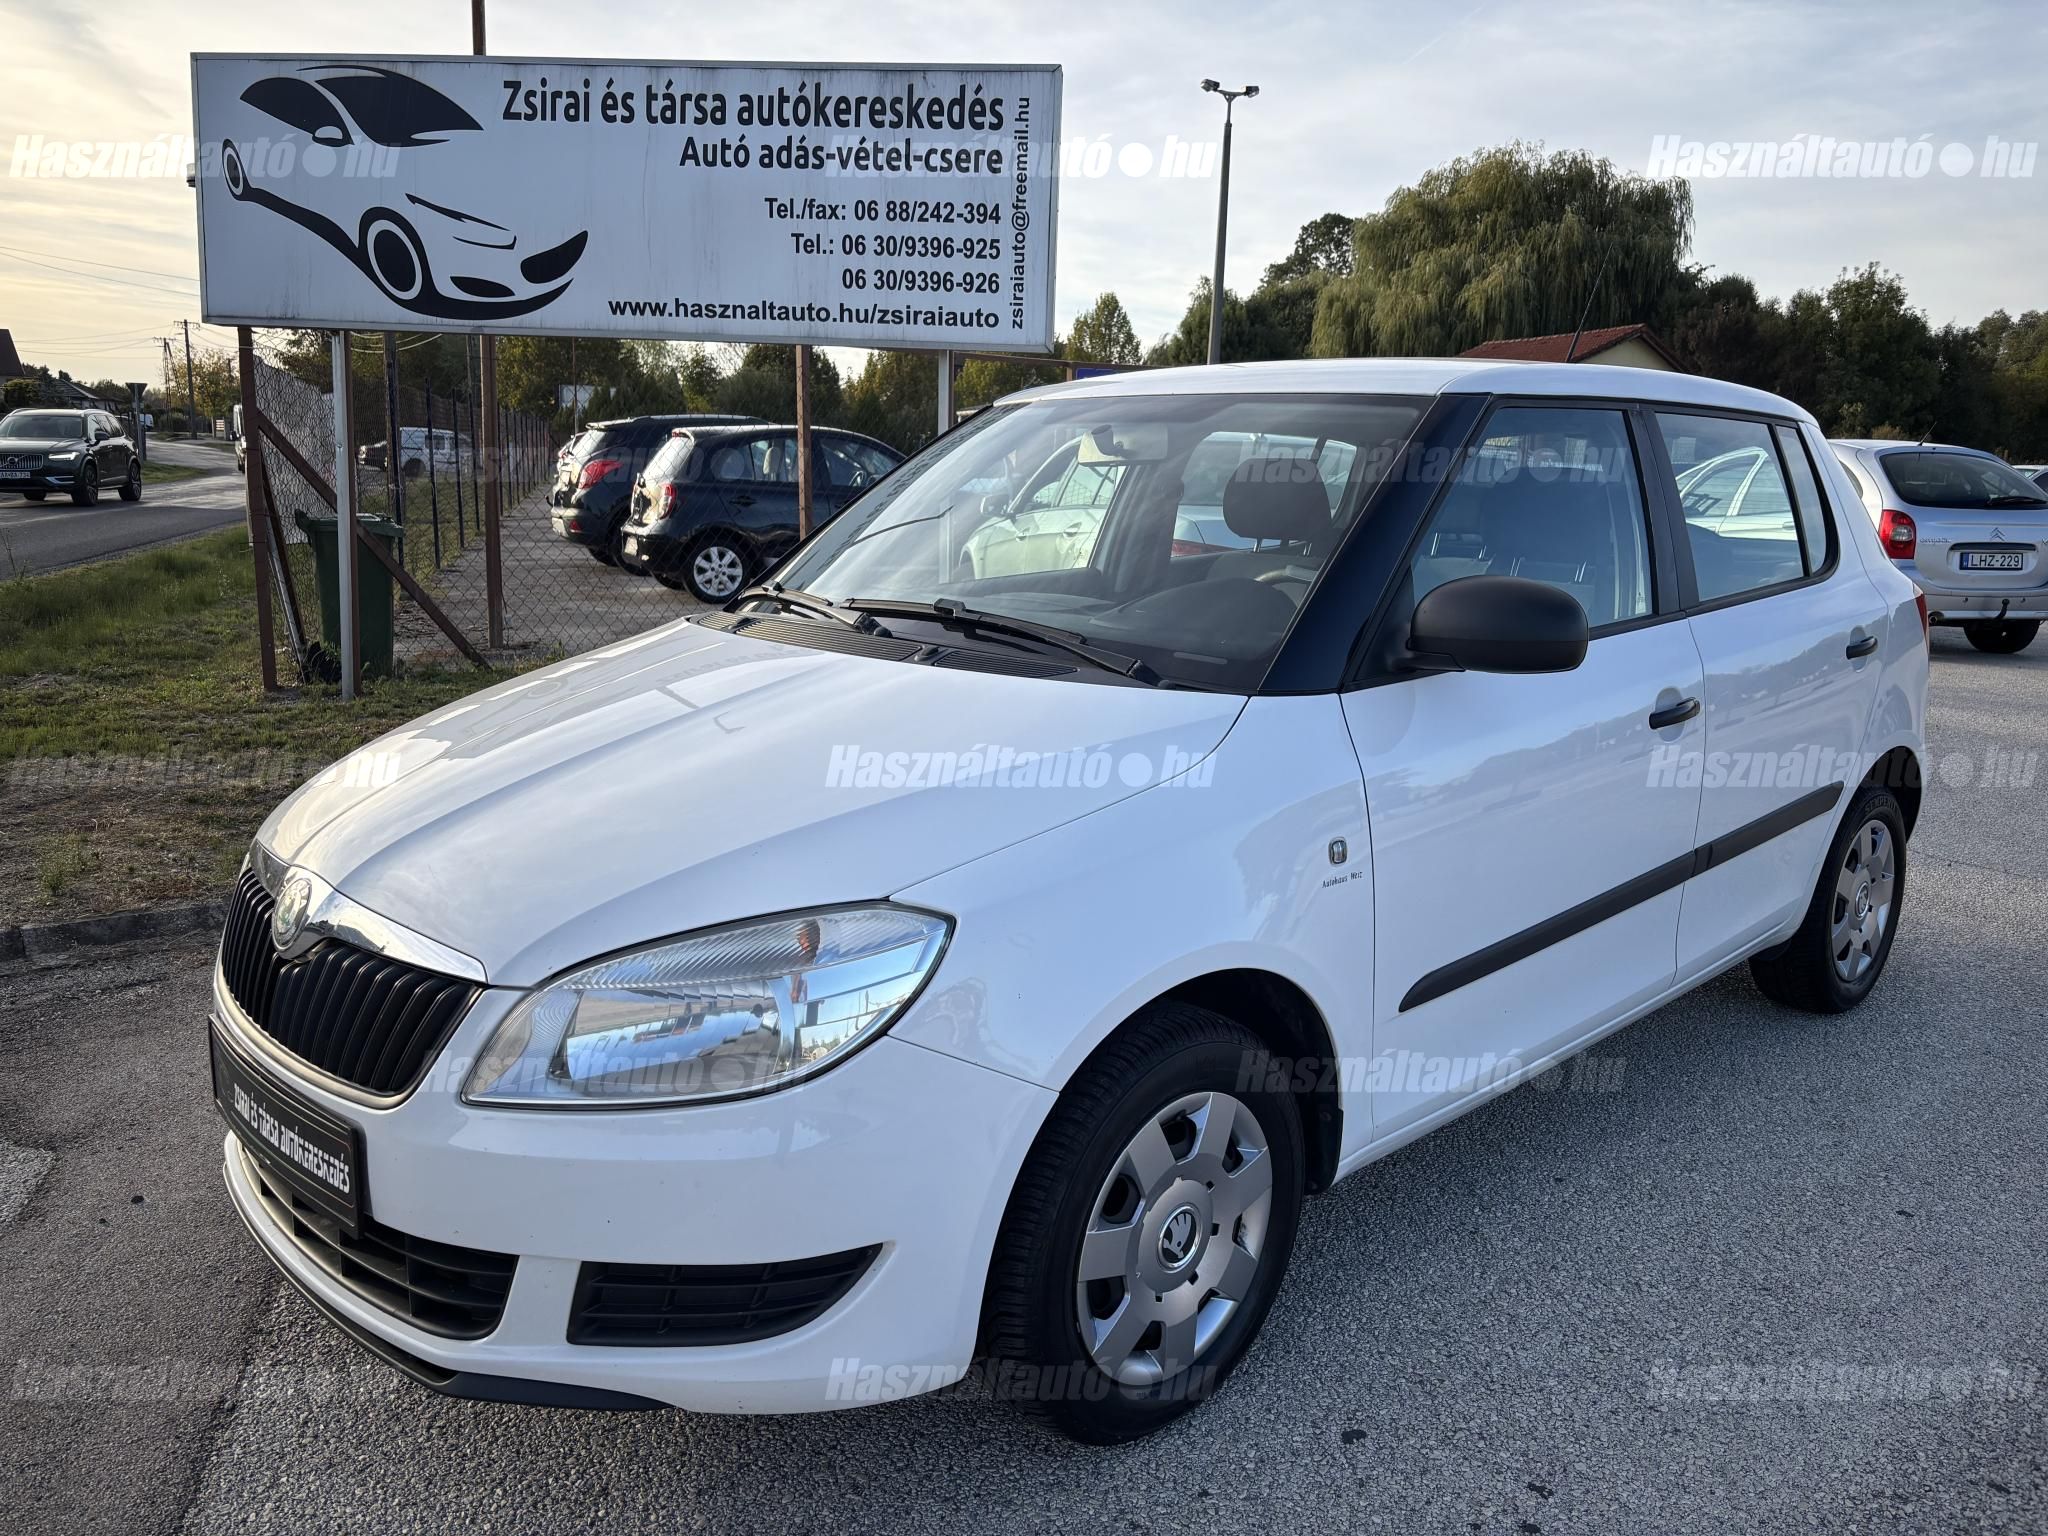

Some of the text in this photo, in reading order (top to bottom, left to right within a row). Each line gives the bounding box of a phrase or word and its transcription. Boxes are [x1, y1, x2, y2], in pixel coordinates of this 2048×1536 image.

[502, 77, 1004, 131] Zsirai és társa autókereskedés
[679, 135, 1003, 174] Autó adás-vétel-csere
[765, 198, 1001, 224] Tel./fax: 06 88/242-394
[1010, 97, 1031, 330] zsiraiauto@freemail.hu
[791, 233, 1001, 260] Tel.: 06 30/9396-925
[841, 269, 1000, 294] 06 30/9396-926
[608, 298, 1000, 329] www.hasznaltauto.hu/zsiraiauto
[1970, 554, 2020, 568] LHZ-229
